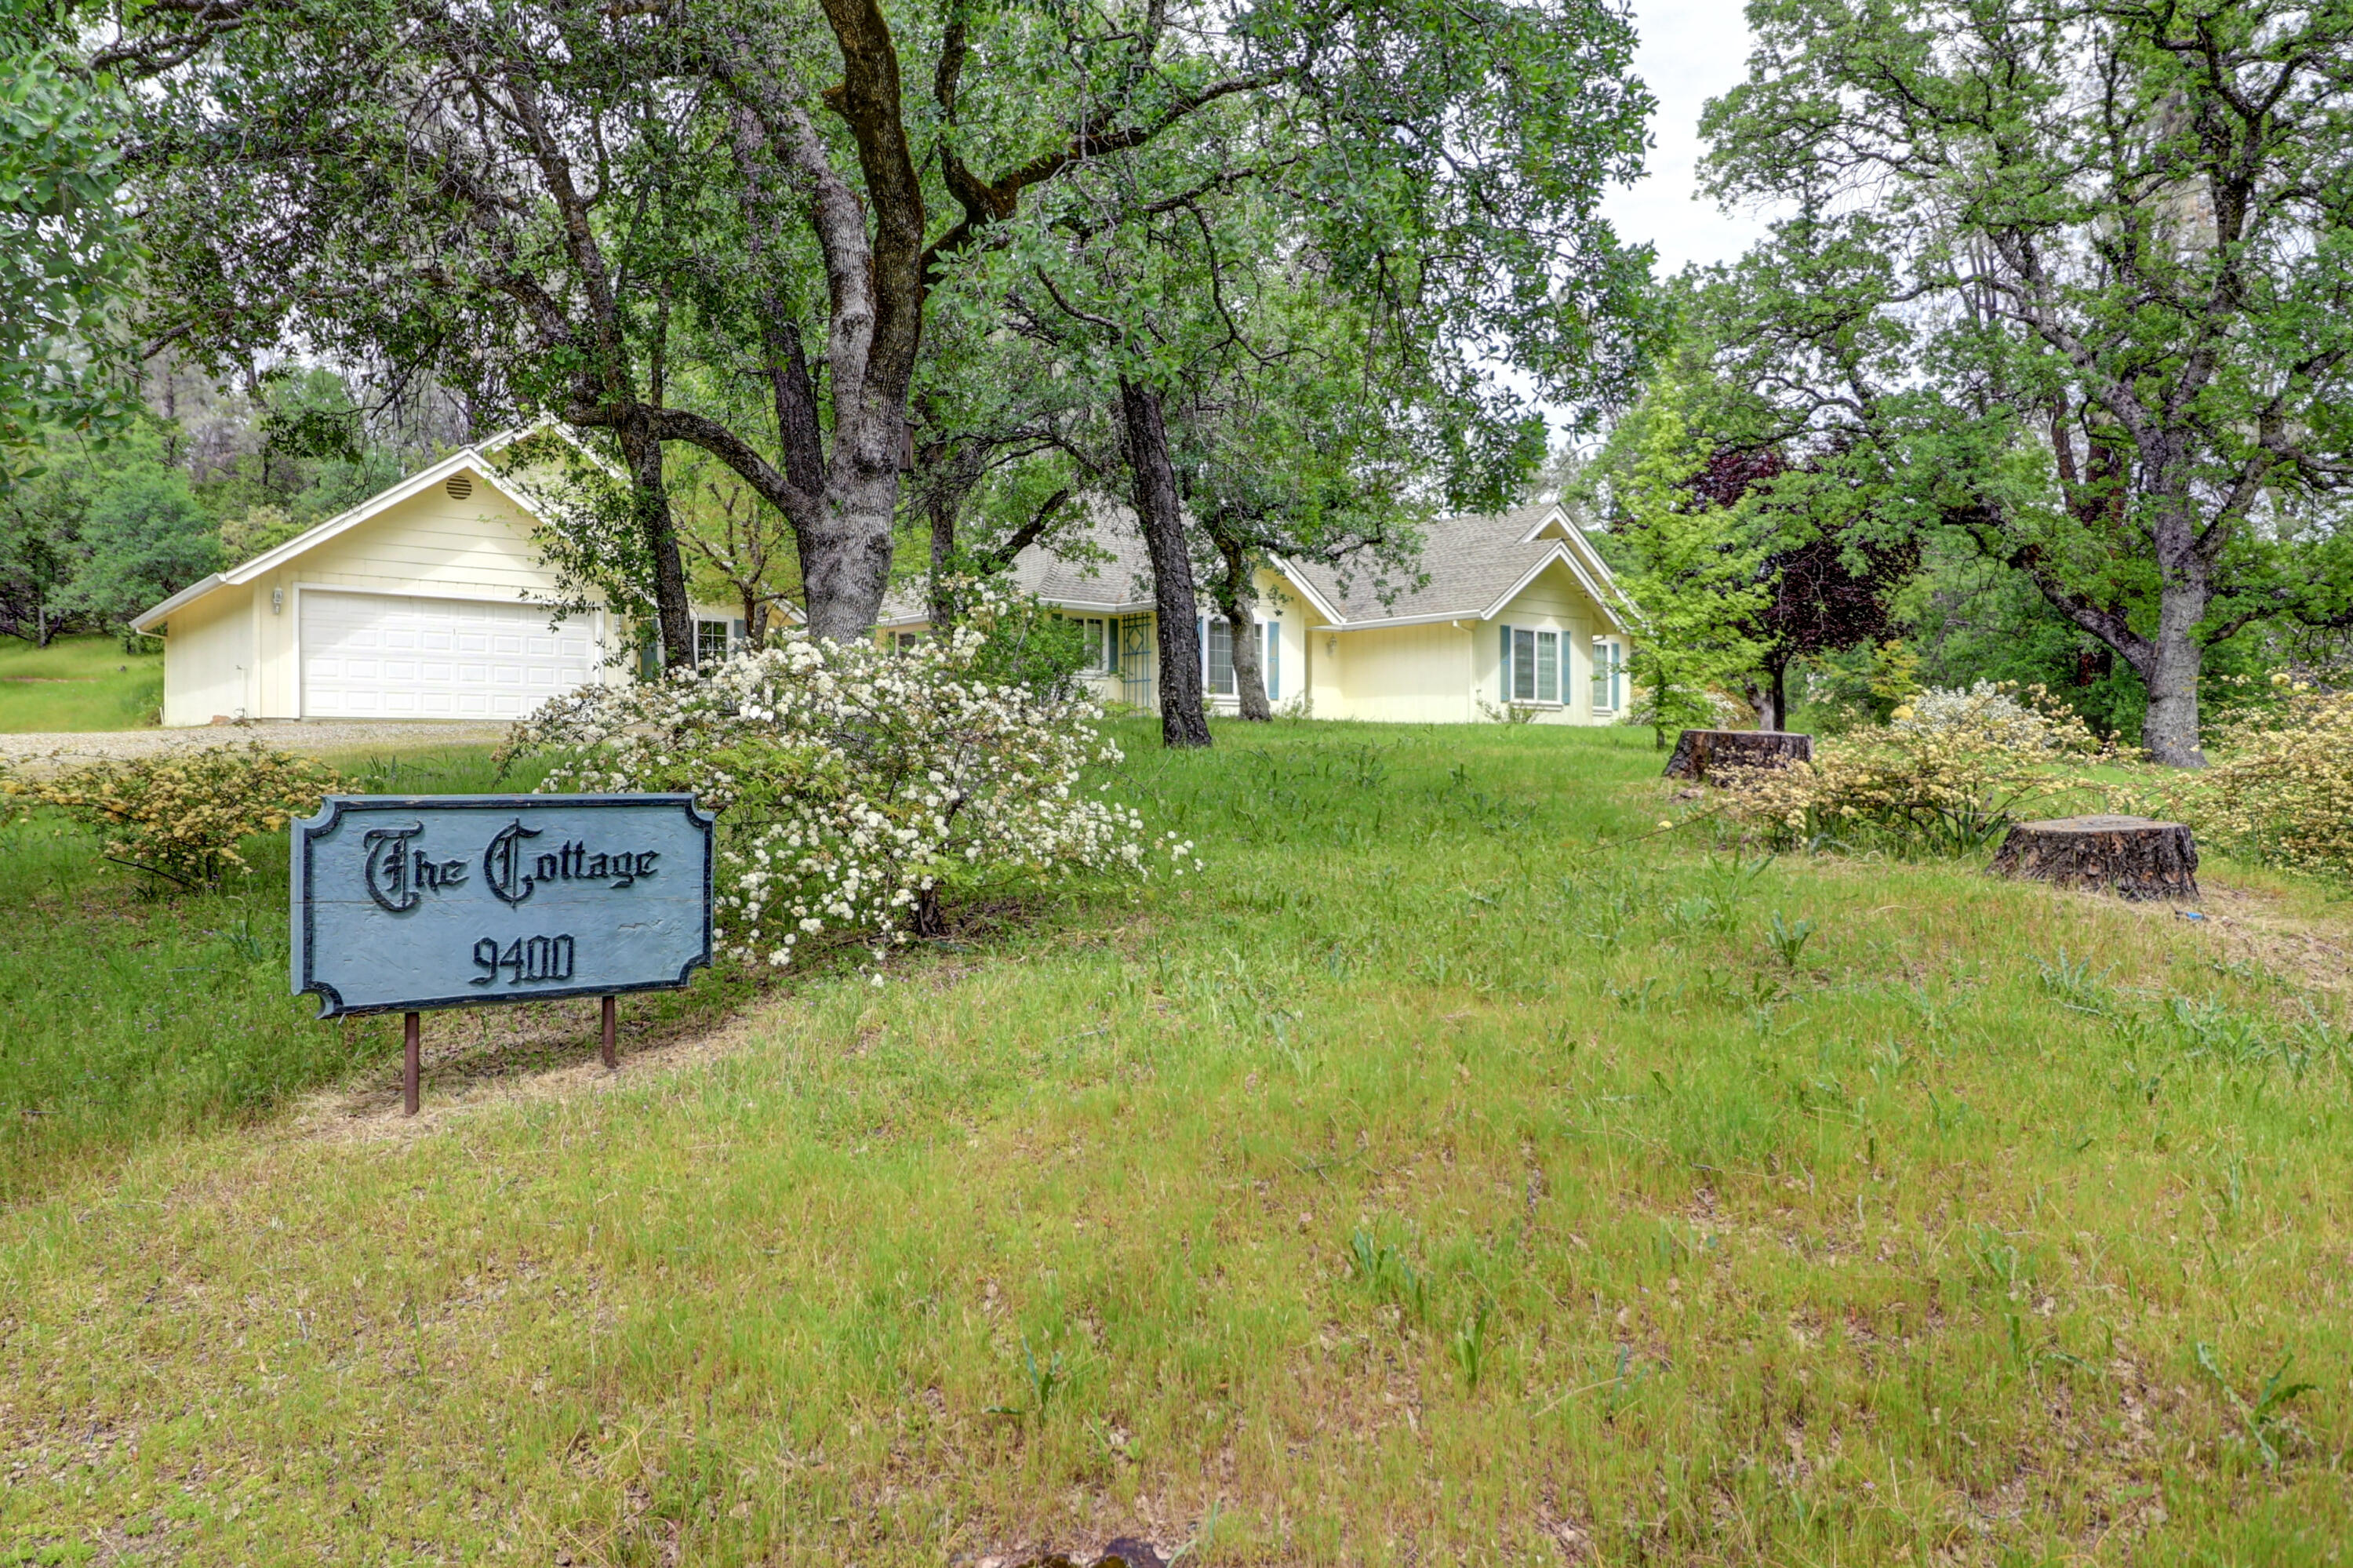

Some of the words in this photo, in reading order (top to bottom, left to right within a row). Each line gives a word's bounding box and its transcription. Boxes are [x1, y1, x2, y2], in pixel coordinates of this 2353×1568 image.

[362, 820, 469, 911] The
[483, 817, 660, 908] Cottage
[469, 933, 574, 984] 9400
